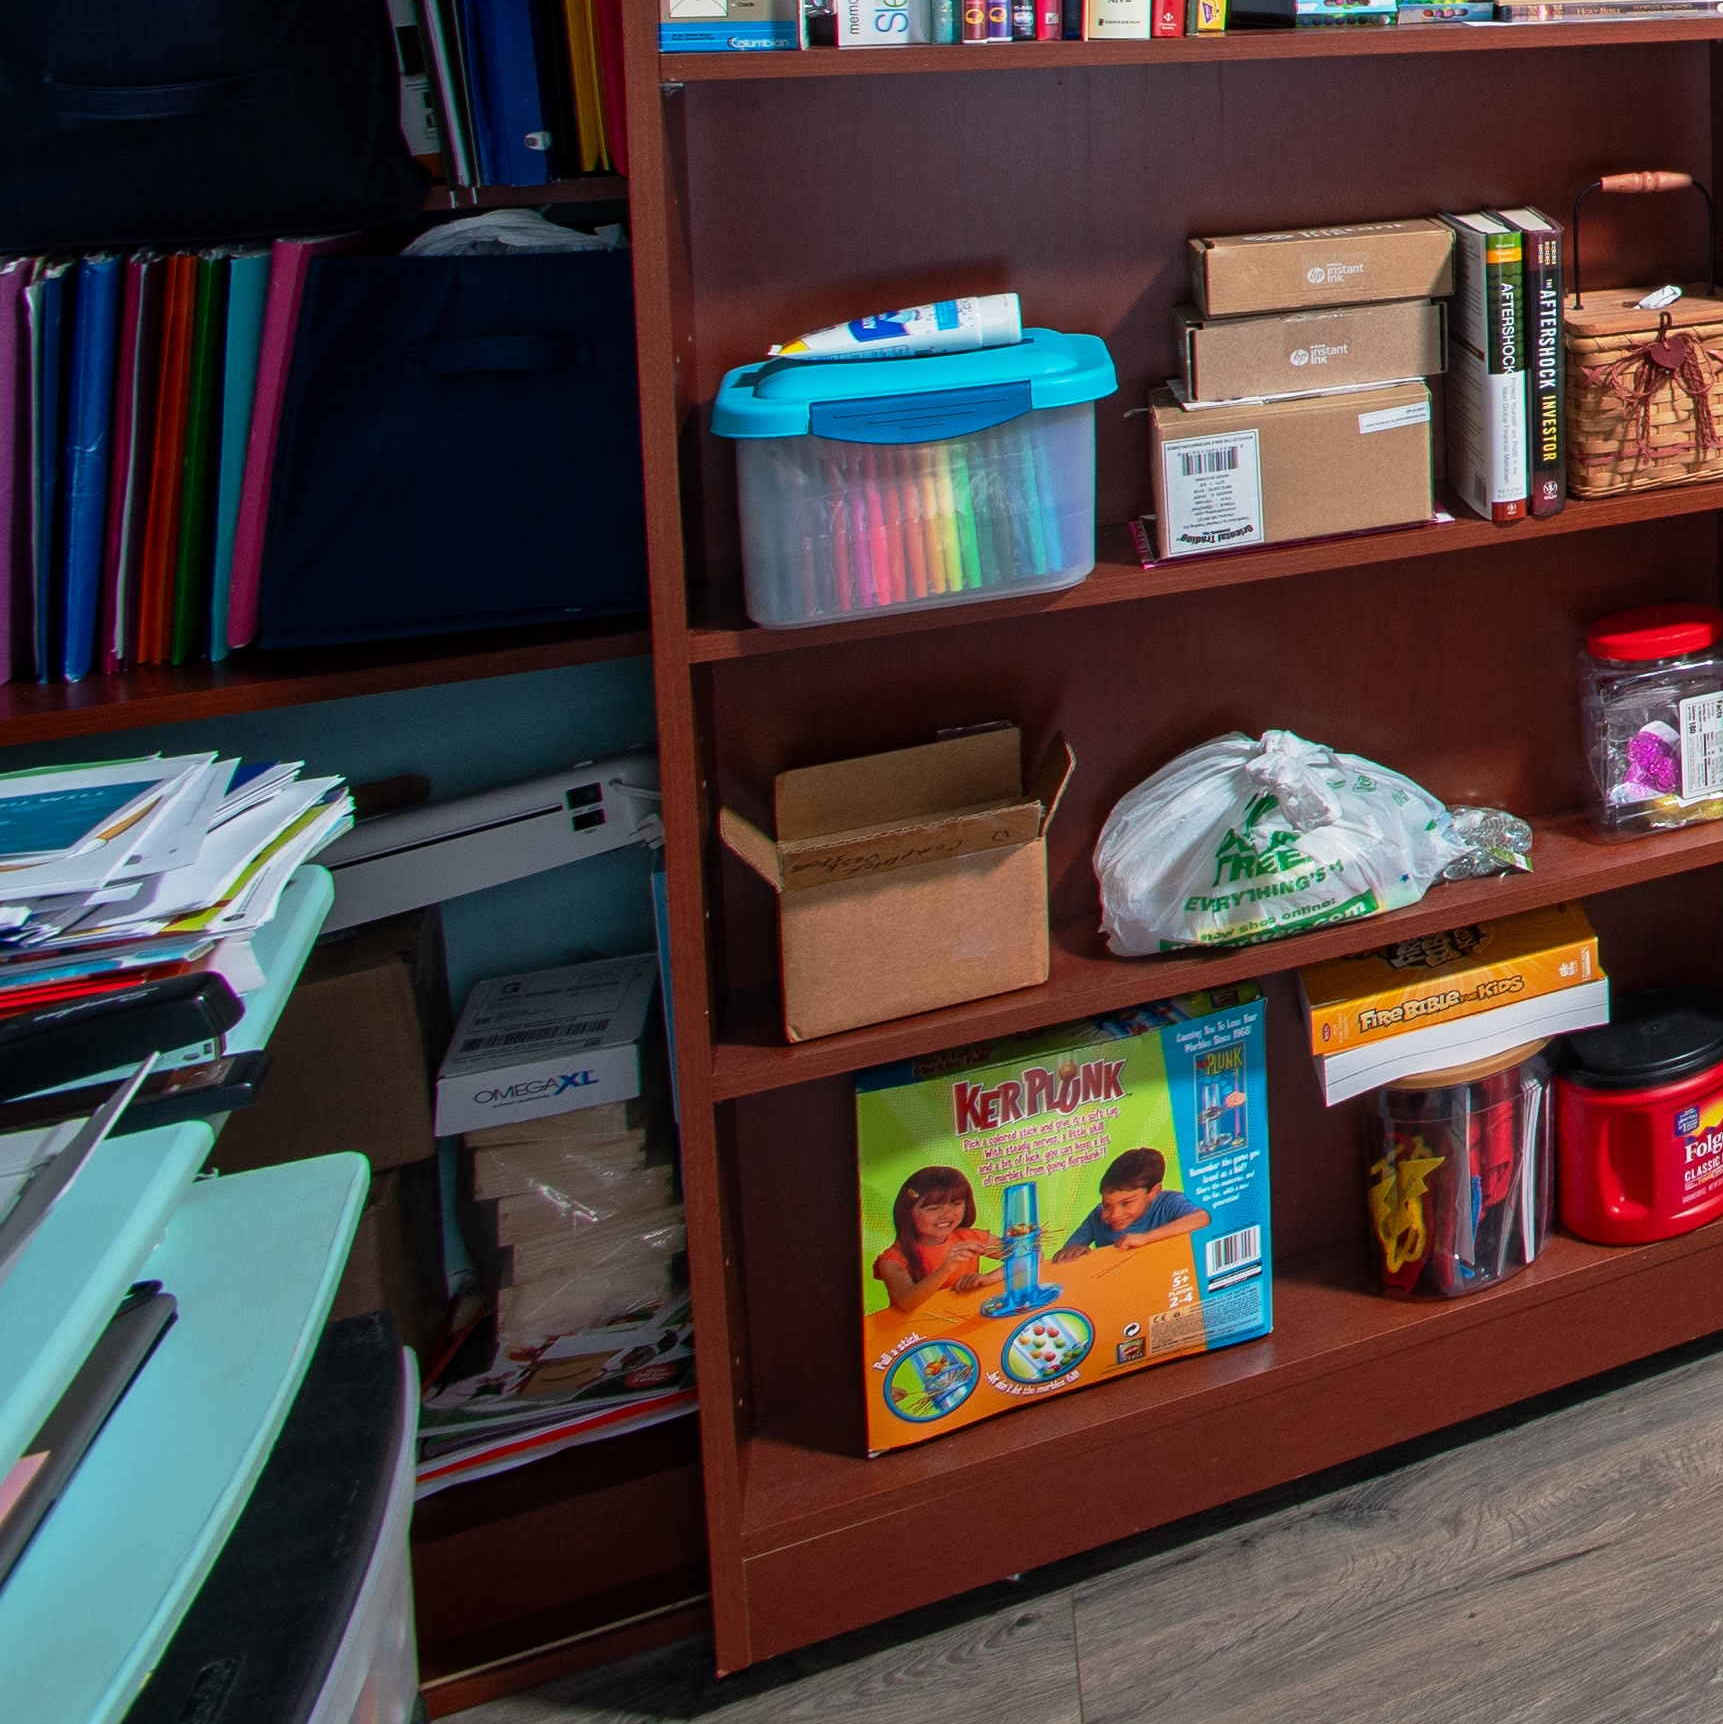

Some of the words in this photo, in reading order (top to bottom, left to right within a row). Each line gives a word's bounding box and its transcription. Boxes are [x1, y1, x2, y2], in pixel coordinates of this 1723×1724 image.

[729, 38, 789, 48] Columbian
[1328, 264, 1364, 274] instant
[1501, 283, 1515, 375] AFTERSHOCK
[1538, 290, 1557, 389] AFTERSHOCK
[1311, 344, 1348, 355] instant
[1542, 395, 1557, 461] INVESTOR
[1180, 534, 1215, 544] Trading
[1218, 525, 1253, 542] Oriental
[1239, 918, 1276, 933] shop
[1282, 899, 1336, 919] online:
[1685, 1155, 1721, 1181] CLASSIC
[1174, 1275, 1188, 1287] 5+
[1170, 1294, 1193, 1308] 2-4
